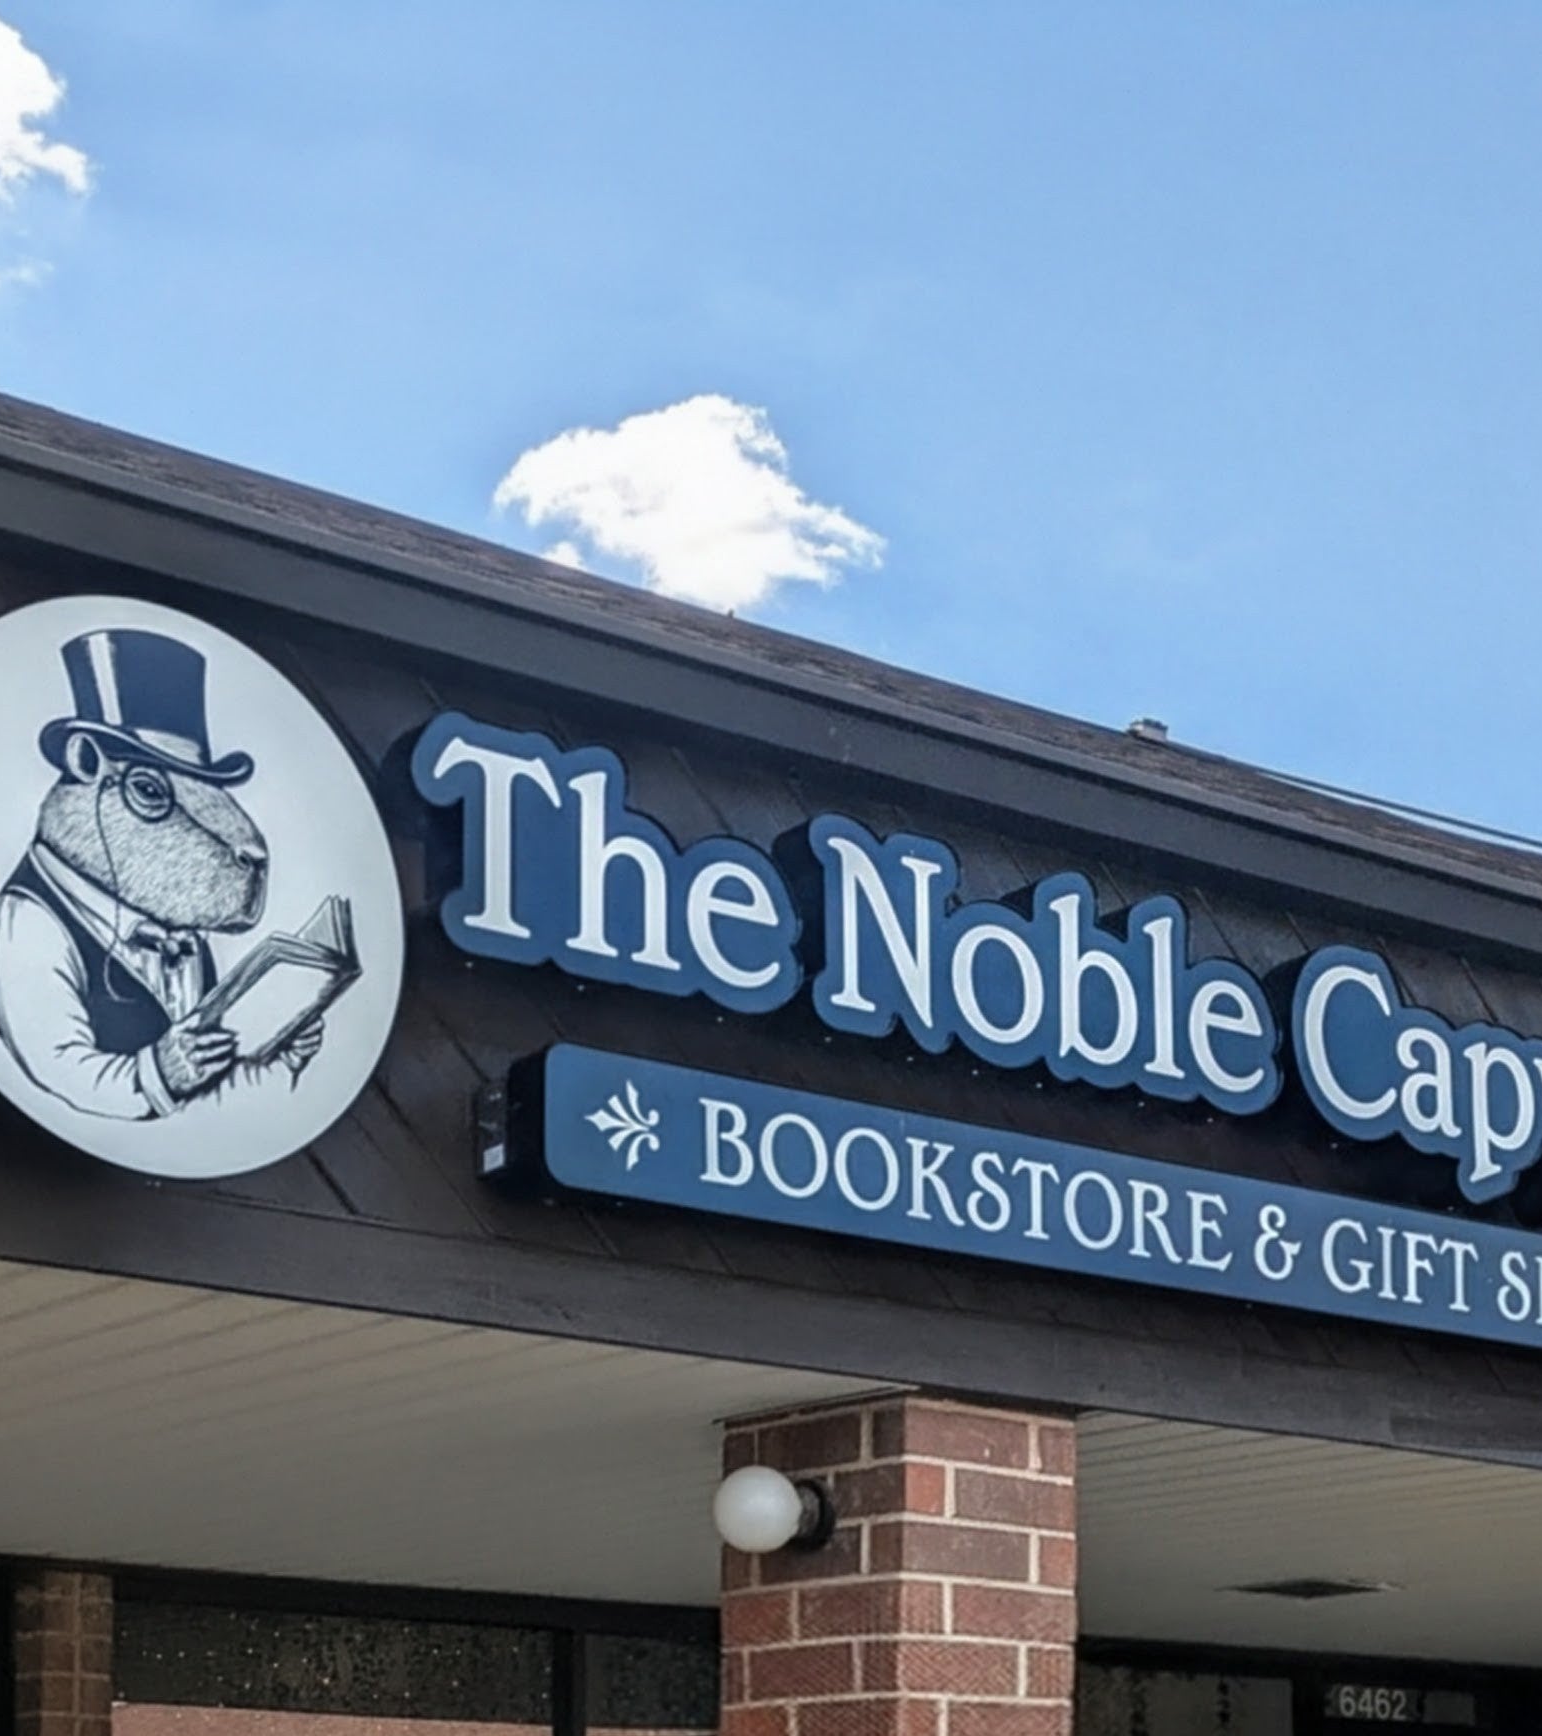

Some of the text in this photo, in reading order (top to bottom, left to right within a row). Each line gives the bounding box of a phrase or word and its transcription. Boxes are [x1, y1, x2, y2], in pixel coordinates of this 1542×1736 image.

[433, 736, 780, 988] The
[827, 837, 1264, 1092] Noble
[699, 1098, 1233, 1272] BOOKSTORE
[1254, 1204, 1302, 1280] &
[1321, 1218, 1479, 1312] GIFT
[1339, 1685, 1407, 1721] 6462
